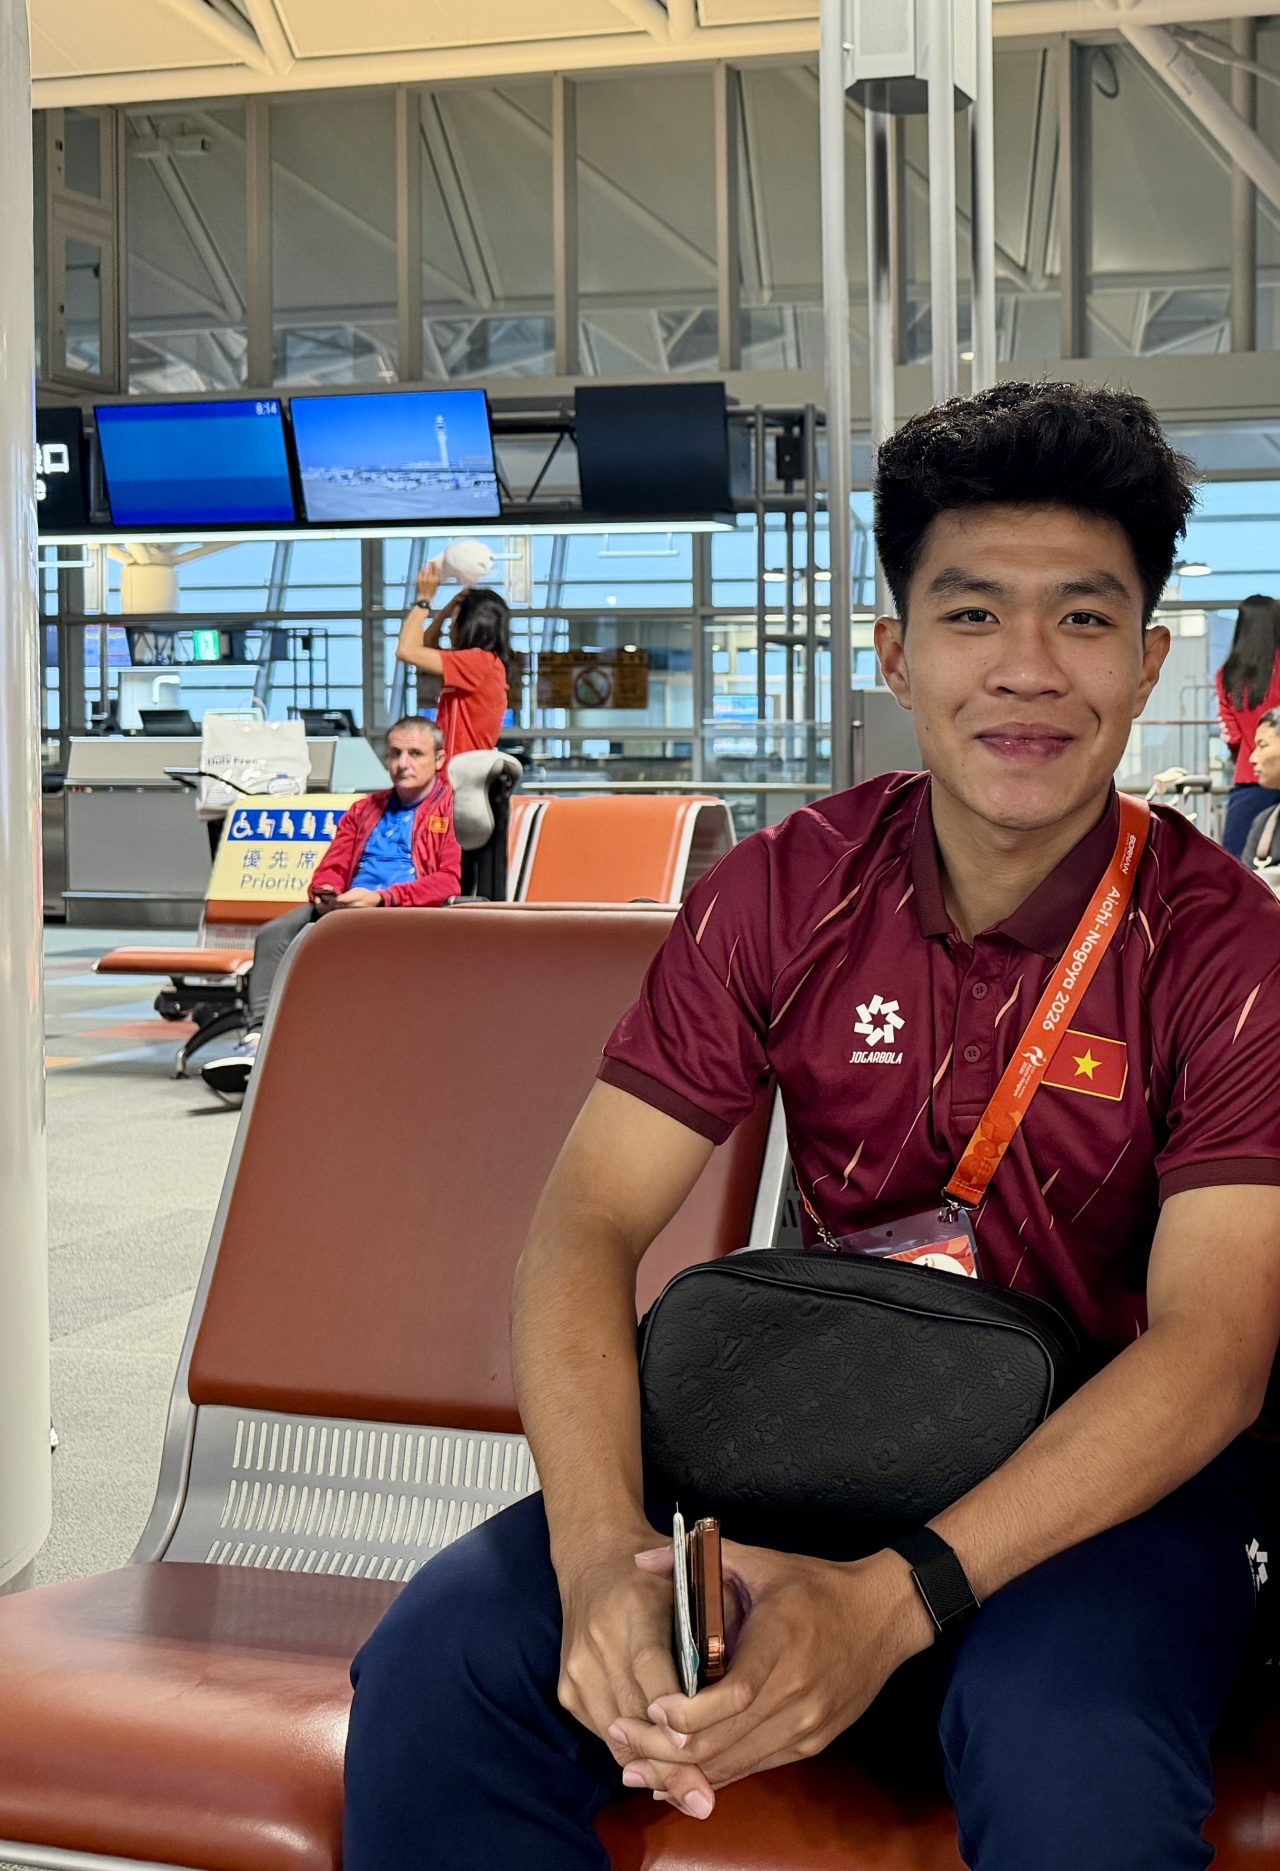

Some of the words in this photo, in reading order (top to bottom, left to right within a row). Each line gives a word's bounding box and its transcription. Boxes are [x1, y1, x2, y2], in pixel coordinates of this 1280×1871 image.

[243, 849, 318, 868] 優先席
[1122, 834, 1137, 875] BORNAN
[240, 872, 308, 890] Priority
[1062, 885, 1121, 990] Aichi-Nagoya
[1042, 990, 1070, 1031] 2026
[849, 1051, 903, 1065] JOGARBOLA
